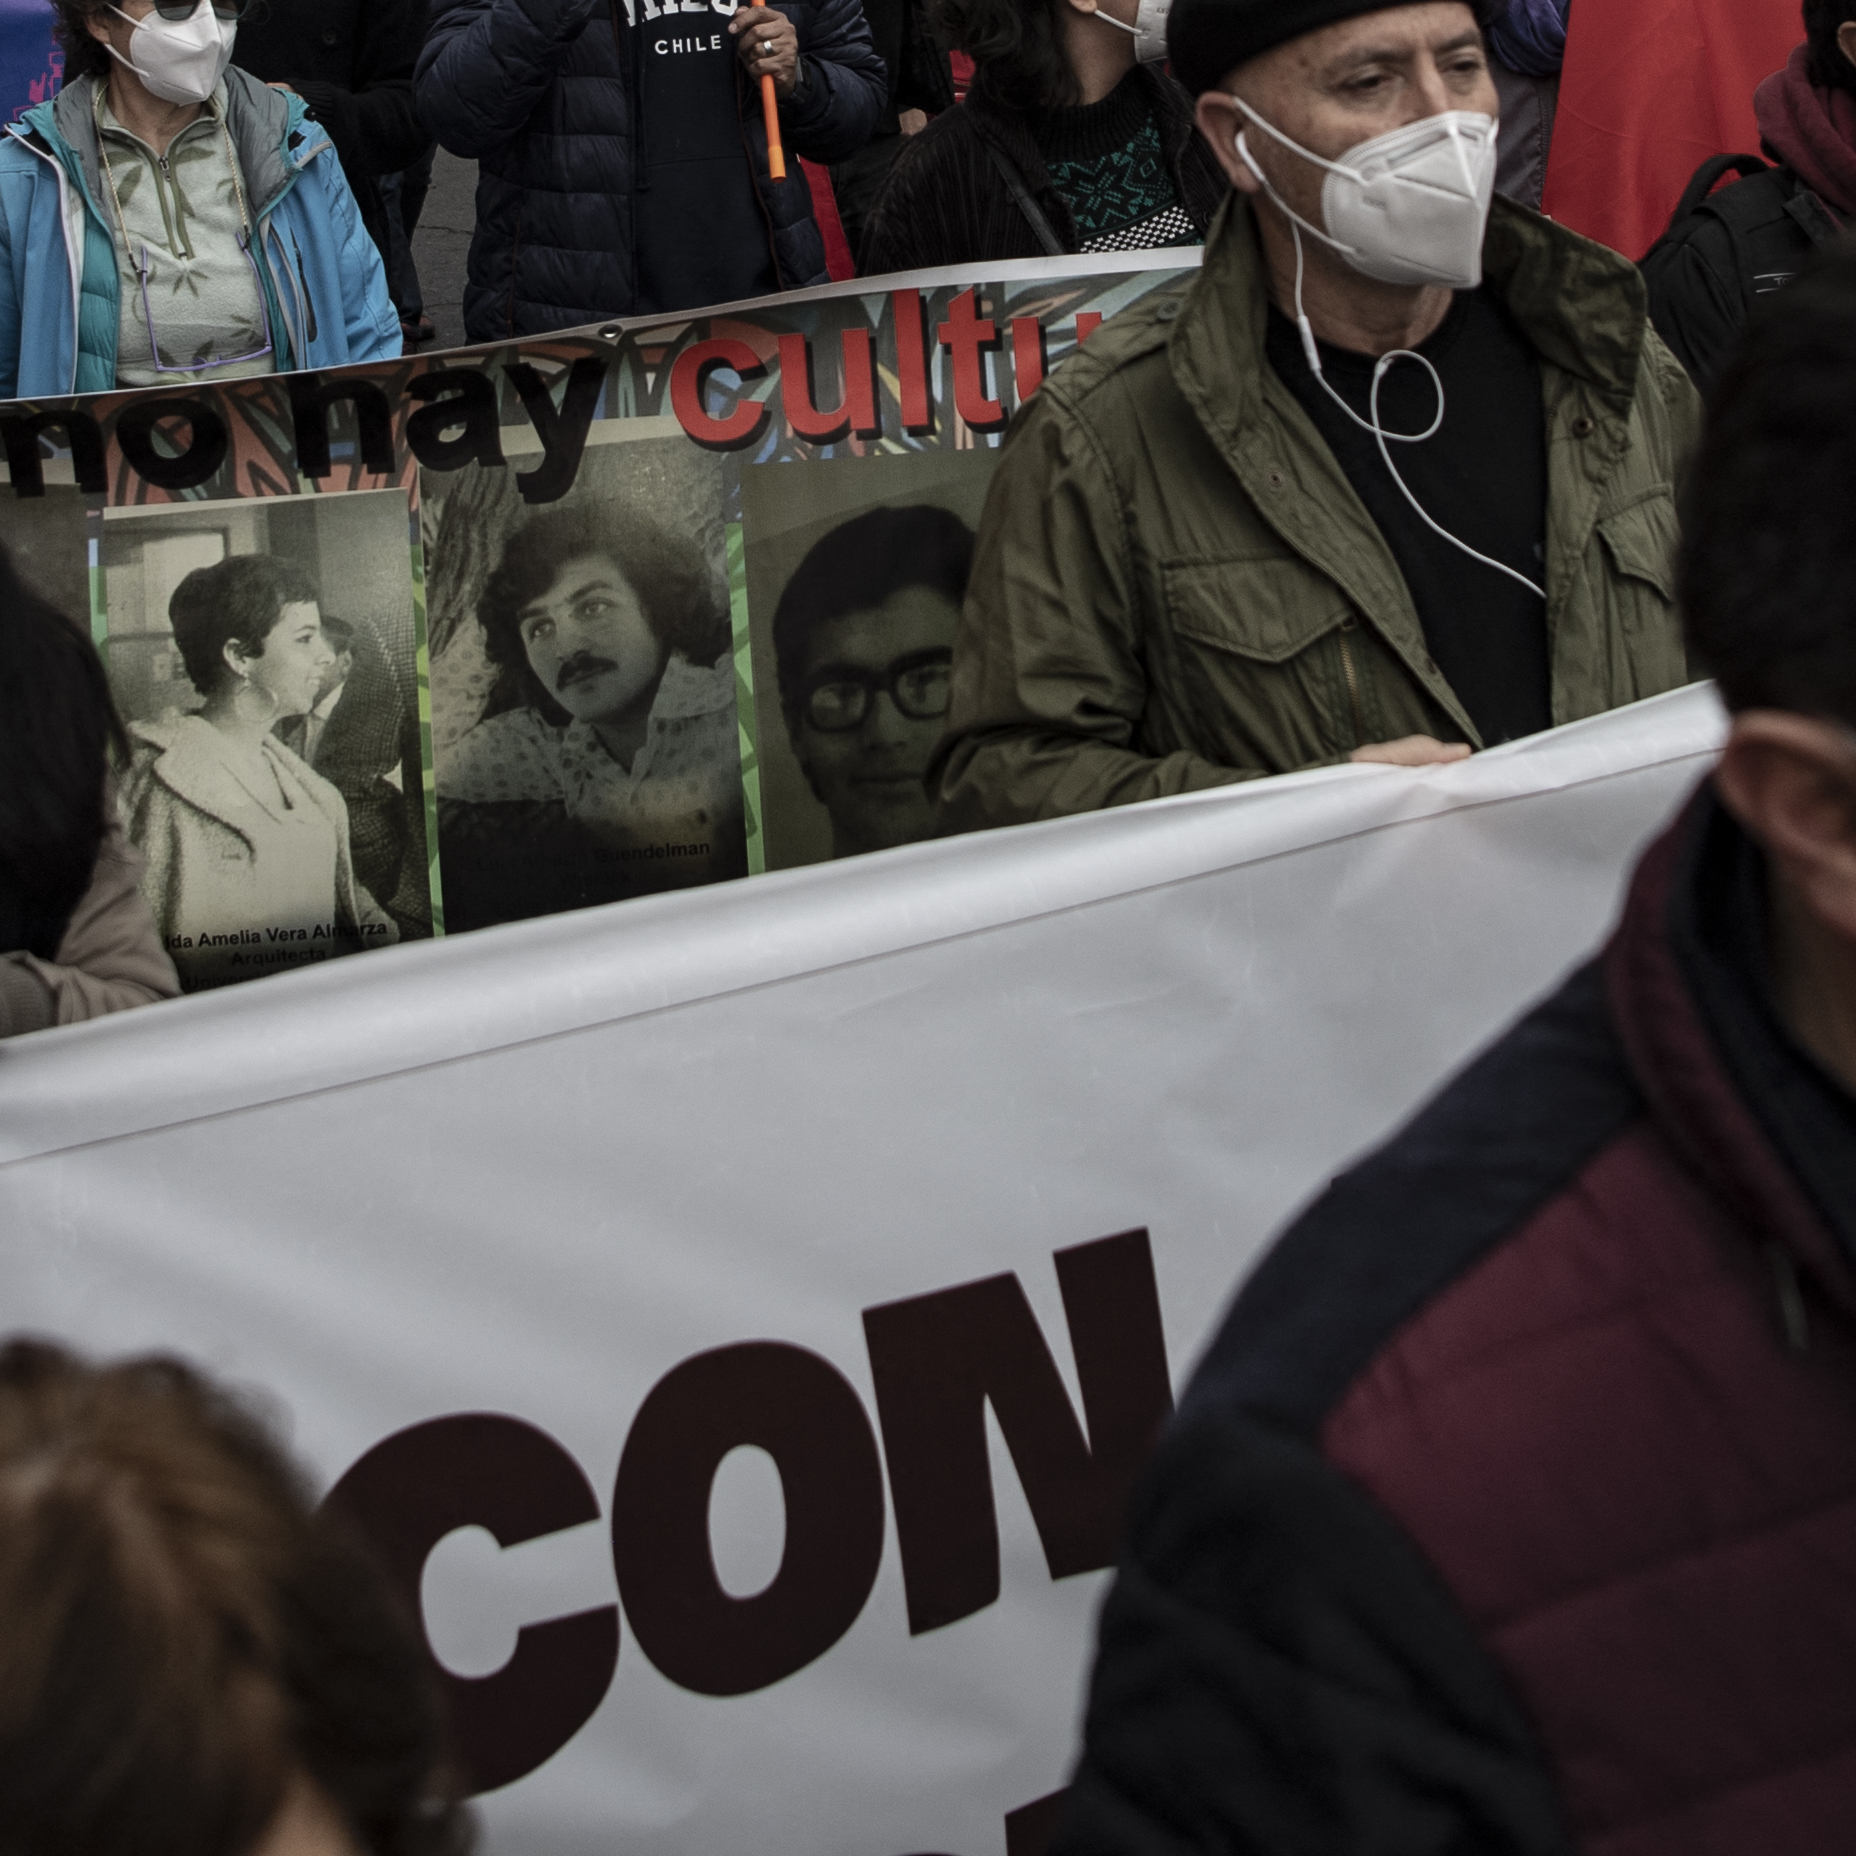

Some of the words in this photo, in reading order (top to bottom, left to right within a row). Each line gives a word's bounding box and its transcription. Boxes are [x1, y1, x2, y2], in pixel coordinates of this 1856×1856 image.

[654, 34, 723, 55] CHILE
[291, 356, 610, 505] hay
[198, 928, 261, 948] Amelia
[265, 926, 308, 943] Vera
[231, 947, 327, 967] Arquitecta
[315, 1225, 1176, 1803] CON
